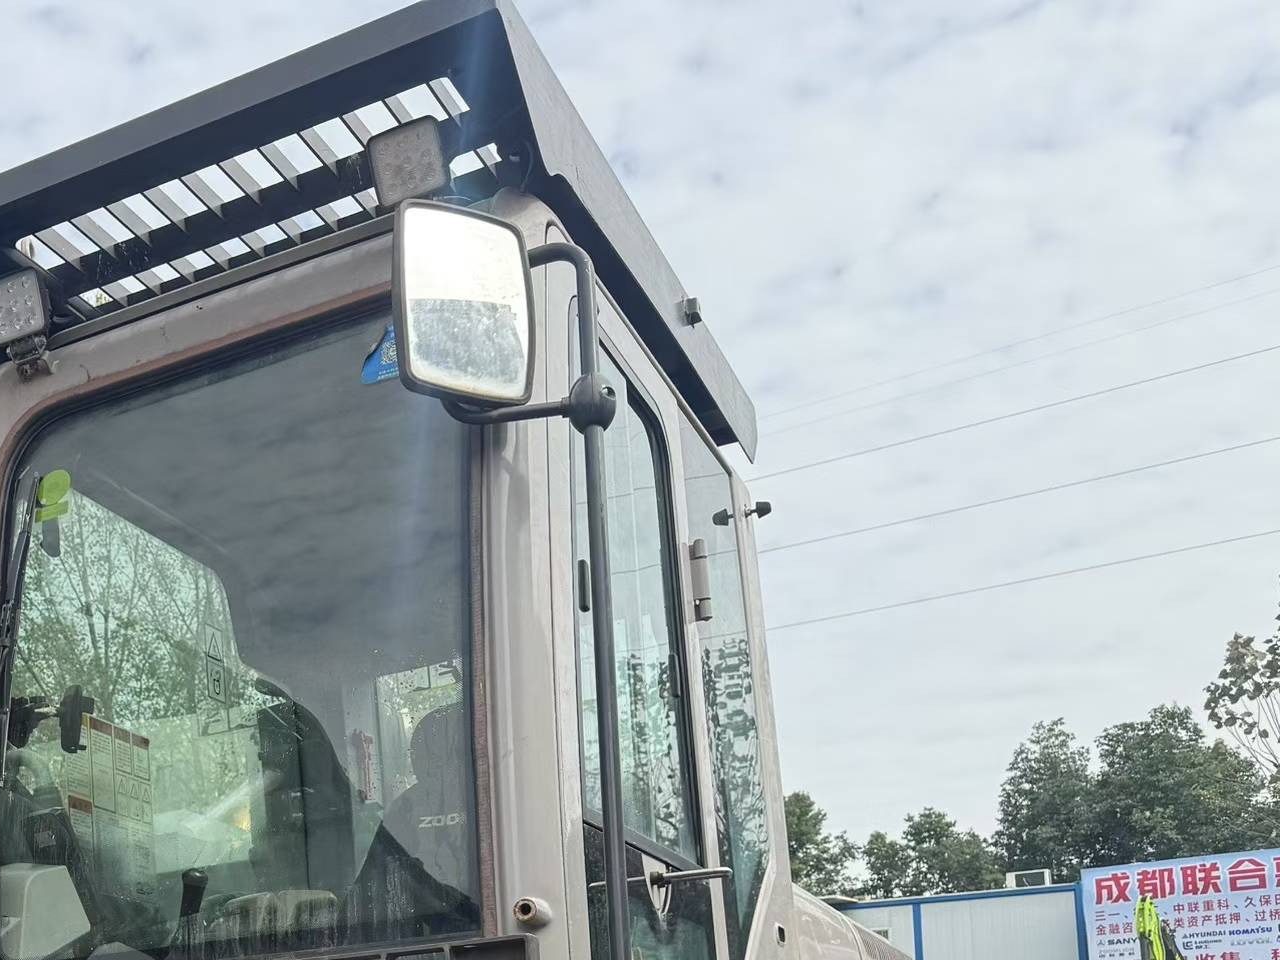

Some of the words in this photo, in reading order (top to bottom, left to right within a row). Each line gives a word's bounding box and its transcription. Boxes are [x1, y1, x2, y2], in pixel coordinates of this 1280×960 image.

[1107, 937, 1138, 946] SANY
[1189, 929, 1226, 939] HYUNDAI
[1228, 925, 1273, 936] KOMATSU
